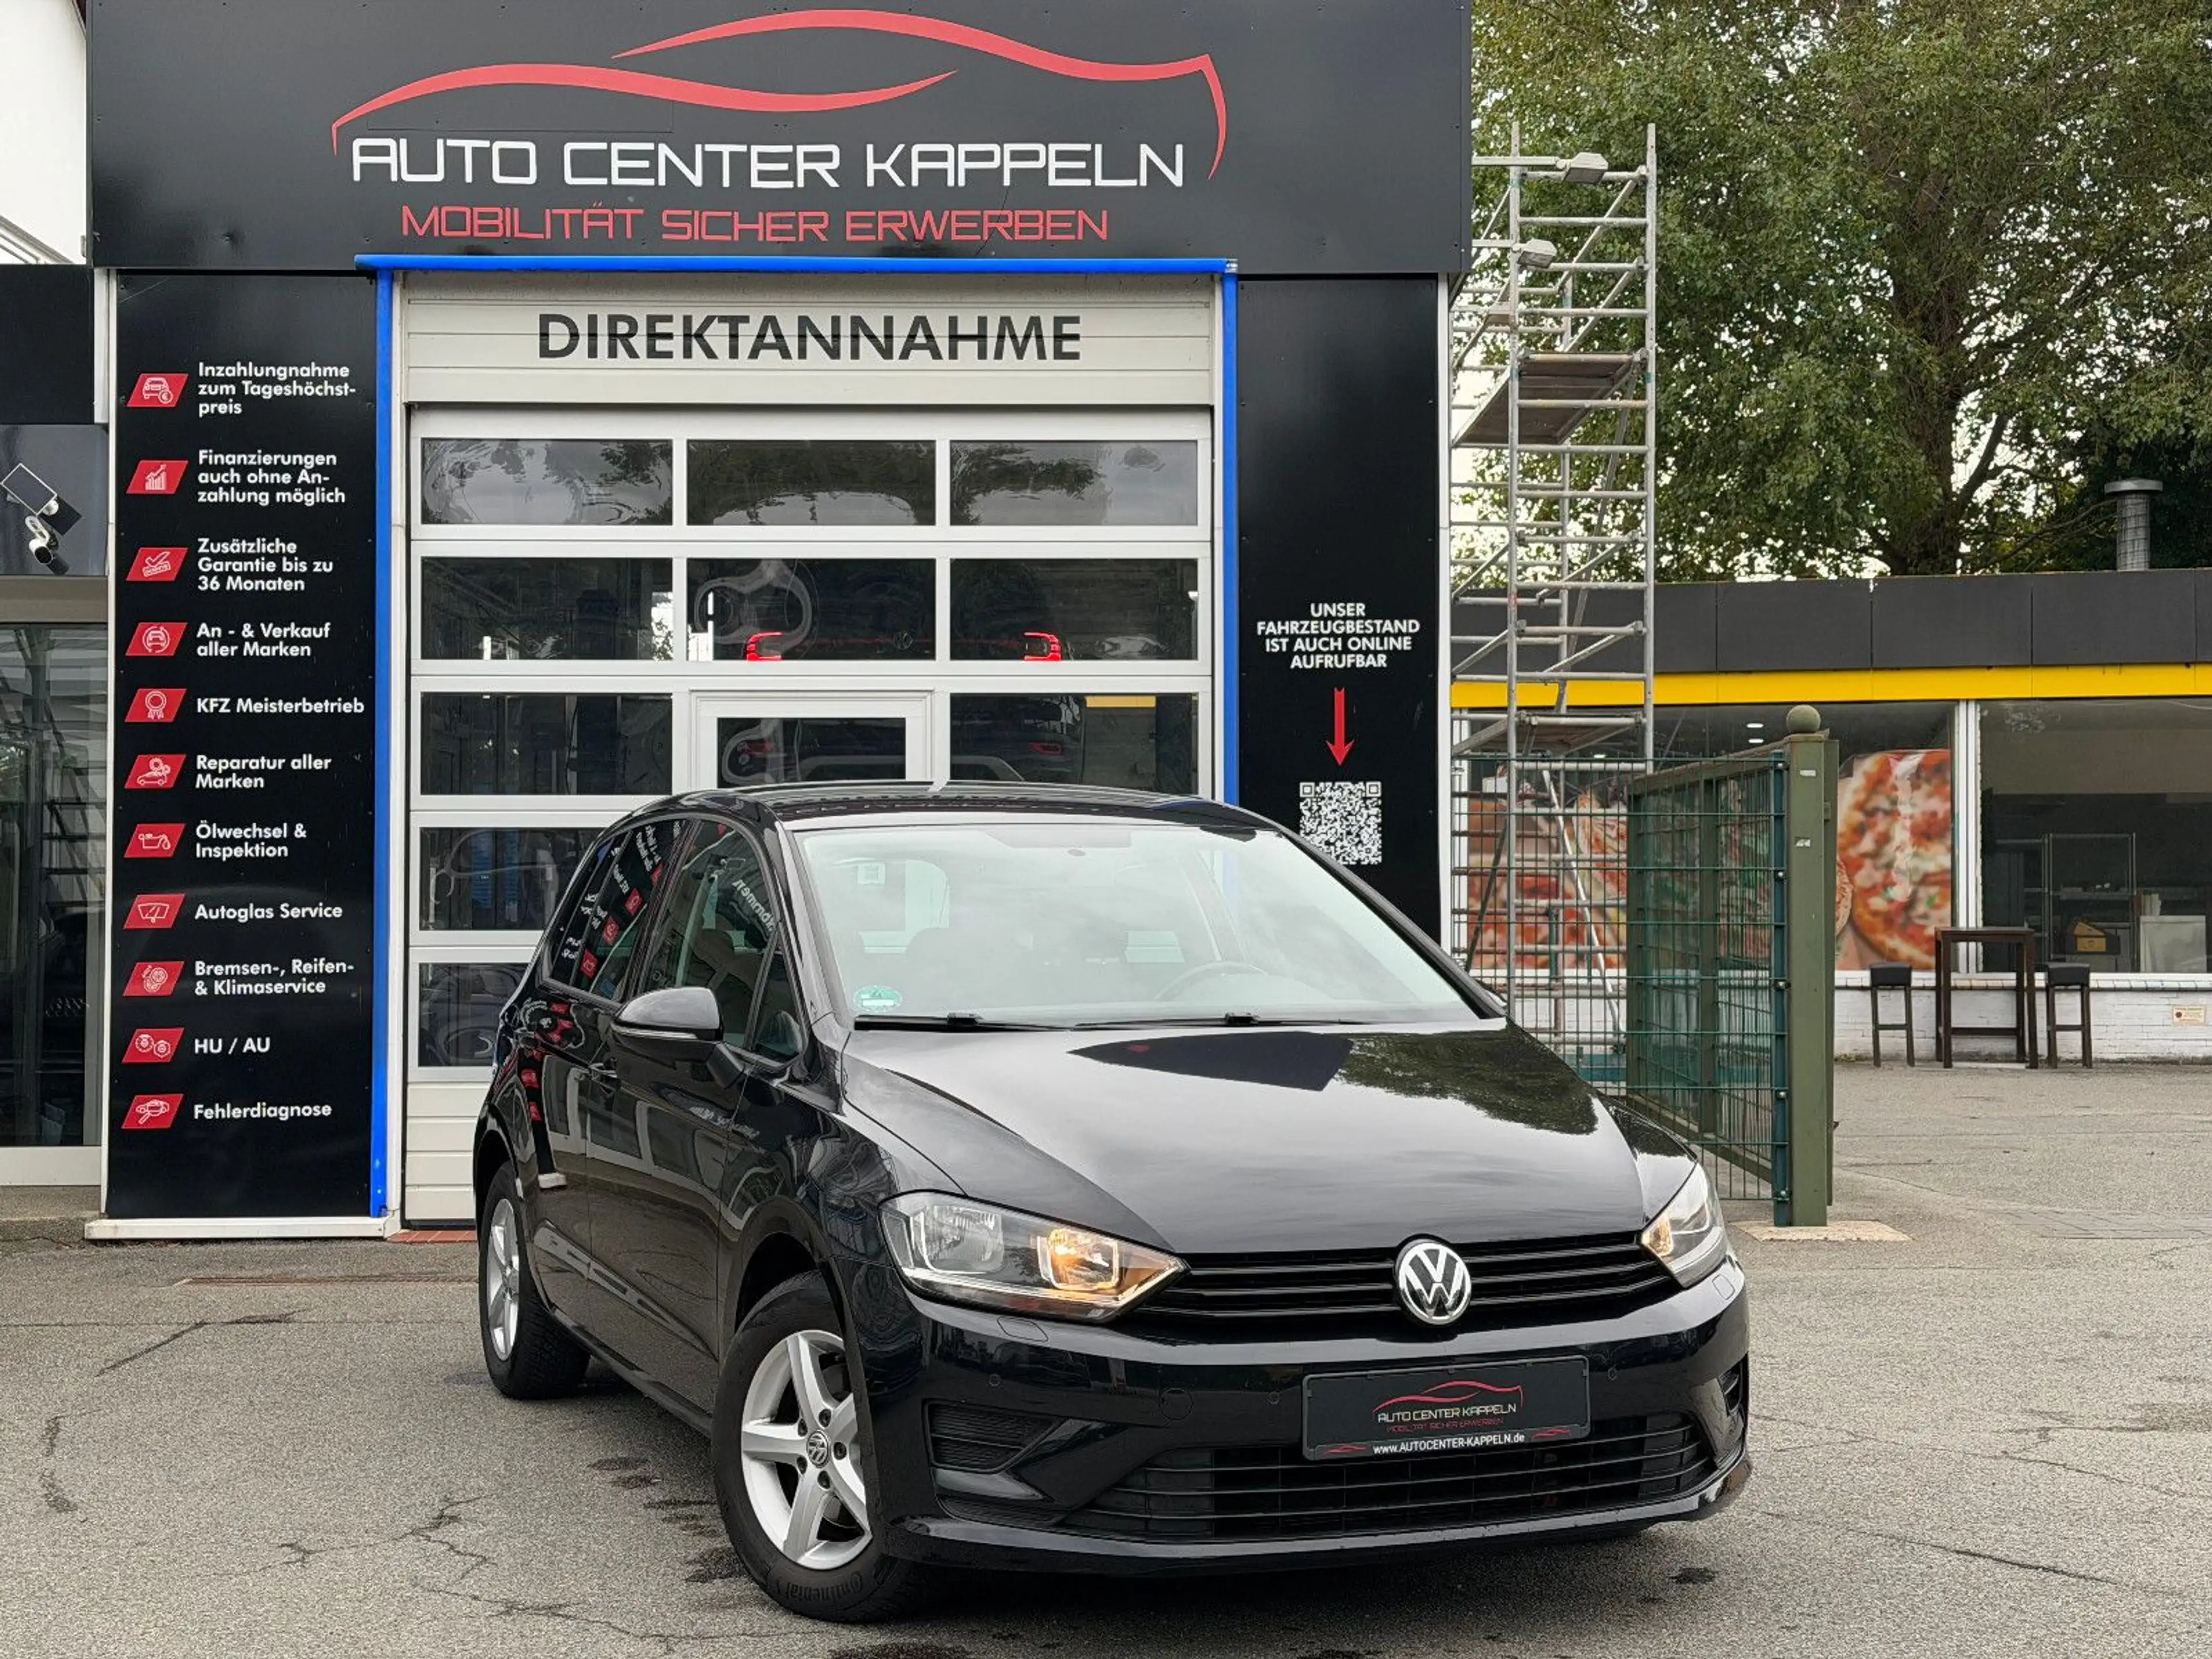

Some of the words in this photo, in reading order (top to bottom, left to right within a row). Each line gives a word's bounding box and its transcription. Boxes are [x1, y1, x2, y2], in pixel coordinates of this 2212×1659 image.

[353, 138, 537, 184] AUTO
[563, 142, 840, 188] CENTER
[866, 143, 1183, 187] KAPPELN
[402, 201, 643, 240] MOBILITÄT
[661, 210, 830, 242] SICHER
[845, 210, 1108, 241] ERWERBEN
[538, 313, 1081, 361] DIREKTANNAHME
[199, 361, 350, 381] Inzahlungnahme
[198, 384, 236, 395] zum
[241, 380, 356, 399] Tageshöchst-
[199, 398, 243, 418] preis
[199, 449, 337, 469] Finanzierungen
[198, 467, 241, 484] auch
[247, 468, 292, 484] ohne
[297, 468, 329, 484] An-
[198, 486, 270, 506] zahlung
[276, 487, 346, 507] möglich
[198, 537, 297, 554] Zusätzliche
[198, 556, 276, 572] Garantie
[282, 556, 308, 573] bis
[312, 561, 333, 573] zu
[198, 575, 221, 591] 36
[225, 575, 305, 591] Monaten
[1310, 603, 1366, 618] UNSER
[196, 622, 222, 638] An
[241, 623, 255, 638] &
[260, 622, 331, 638] Verkauf
[1257, 619, 1421, 635] FAHRZEUGBESTAND
[196, 641, 238, 657] aller
[243, 641, 311, 657] Marken
[1266, 638, 1289, 652] IST
[1293, 637, 1342, 652] AUCH
[1347, 636, 1412, 651] ONLINE
[1290, 653, 1387, 669] AUFRUFBAR
[197, 698, 231, 713] KFZ
[236, 697, 365, 713] Meisterbetrieb
[196, 755, 286, 774] Reparatur
[290, 755, 332, 770] aller
[195, 772, 264, 789] Marken
[196, 820, 287, 839] Ölwechsel
[294, 823, 306, 838] &
[196, 842, 288, 862] Inspektion
[195, 903, 274, 923] Autoglas
[279, 902, 343, 919] Service
[195, 960, 286, 977] Bremsen-,
[291, 958, 355, 974] Reifen-
[195, 980, 208, 996] &
[214, 978, 326, 995] Klimaservice
[195, 1038, 222, 1054] HU
[243, 1037, 270, 1053] AU
[194, 1101, 332, 1121] Fehlerdiagnose
[1399, 1242, 1471, 1325] VW
[1378, 1411, 1411, 1423] AUTO
[1413, 1407, 1460, 1421] CENTER
[1463, 1403, 1516, 1416] KAPPELN
[1373, 1433, 1525, 1454] www.AUTOCENTER-KAPPELN.de
